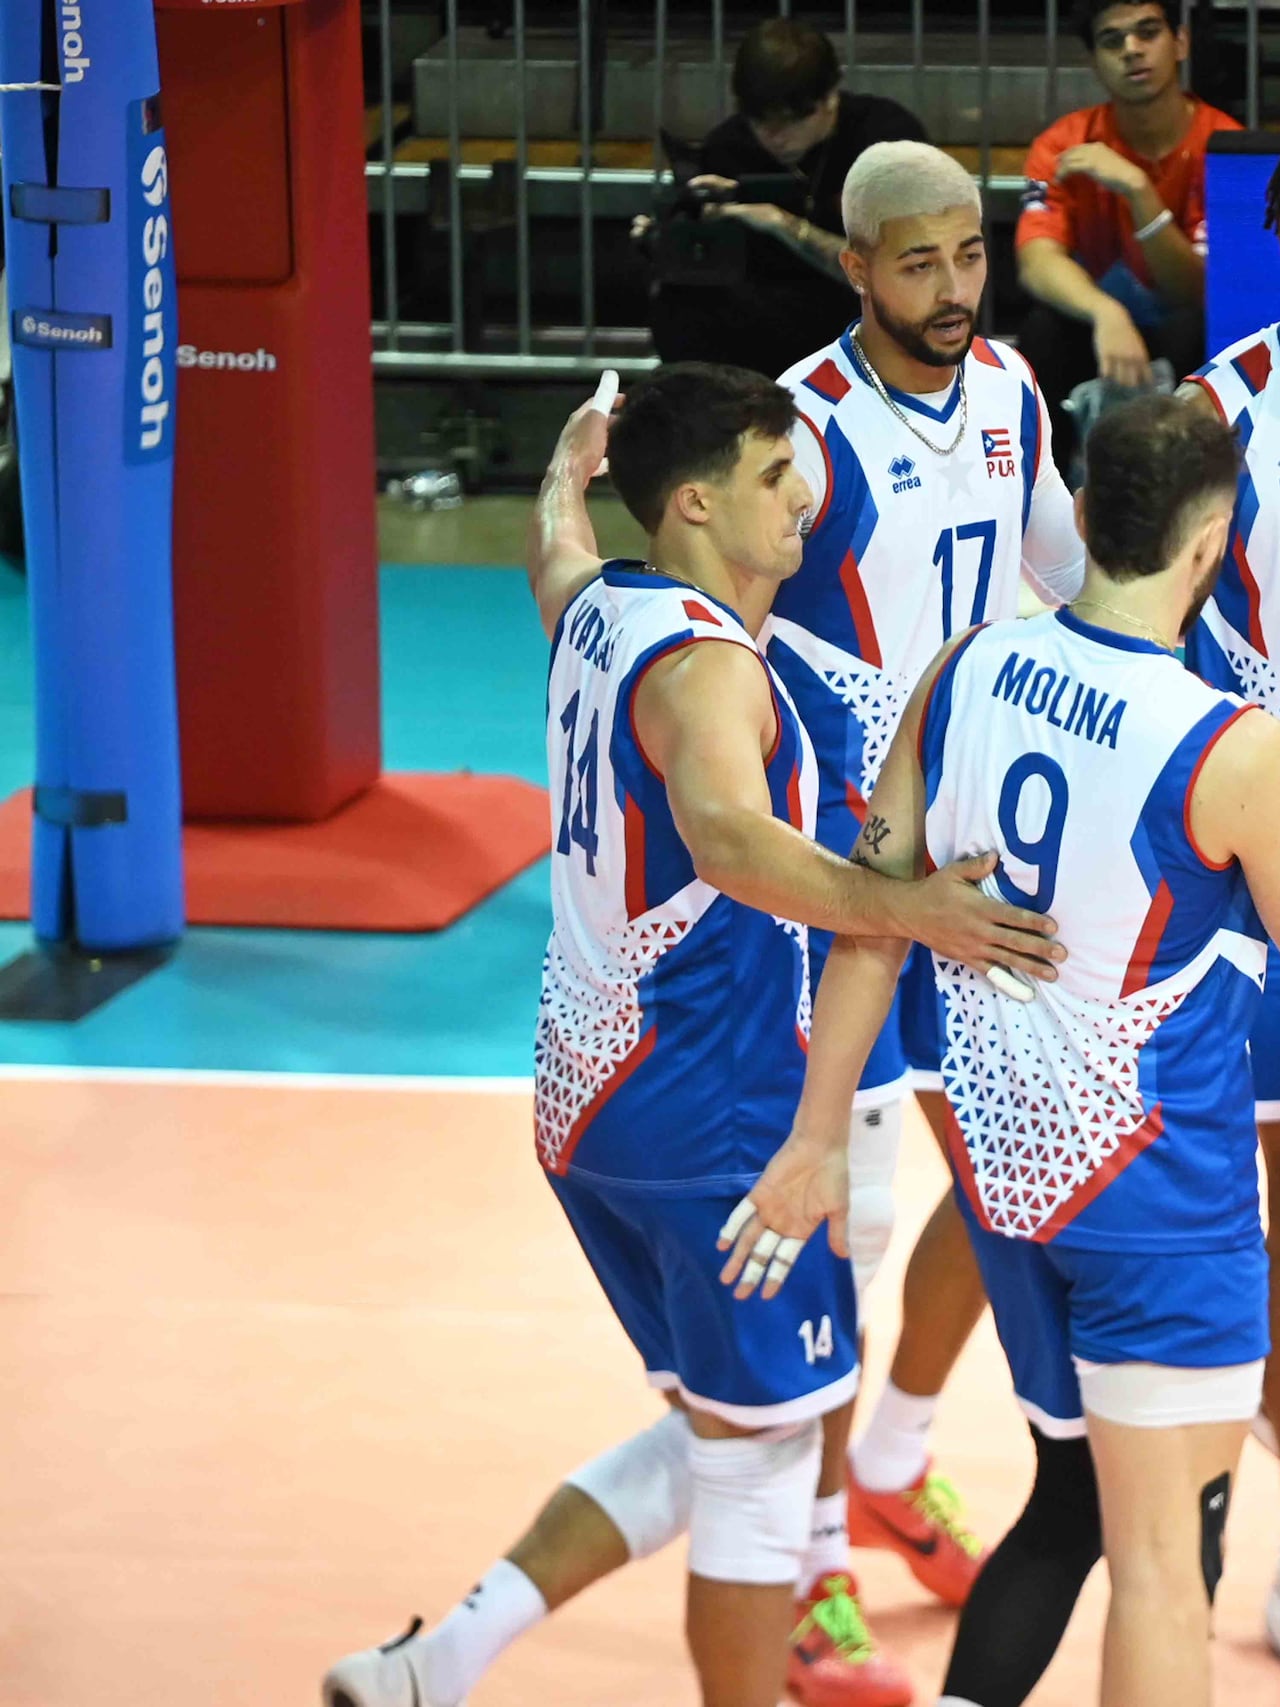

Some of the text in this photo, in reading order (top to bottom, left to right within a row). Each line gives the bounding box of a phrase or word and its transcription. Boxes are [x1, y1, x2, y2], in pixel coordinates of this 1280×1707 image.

[62, 0, 90, 83] noh
[36, 321, 103, 343] Senoh
[140, 214, 169, 450] Senoh
[176, 344, 276, 371] Senoh
[986, 459, 1016, 479] PUR
[932, 519, 997, 640] 17
[991, 651, 1128, 750] MOLINA
[556, 689, 599, 877] 14
[994, 752, 1069, 915] 9
[797, 1314, 834, 1365] 14
